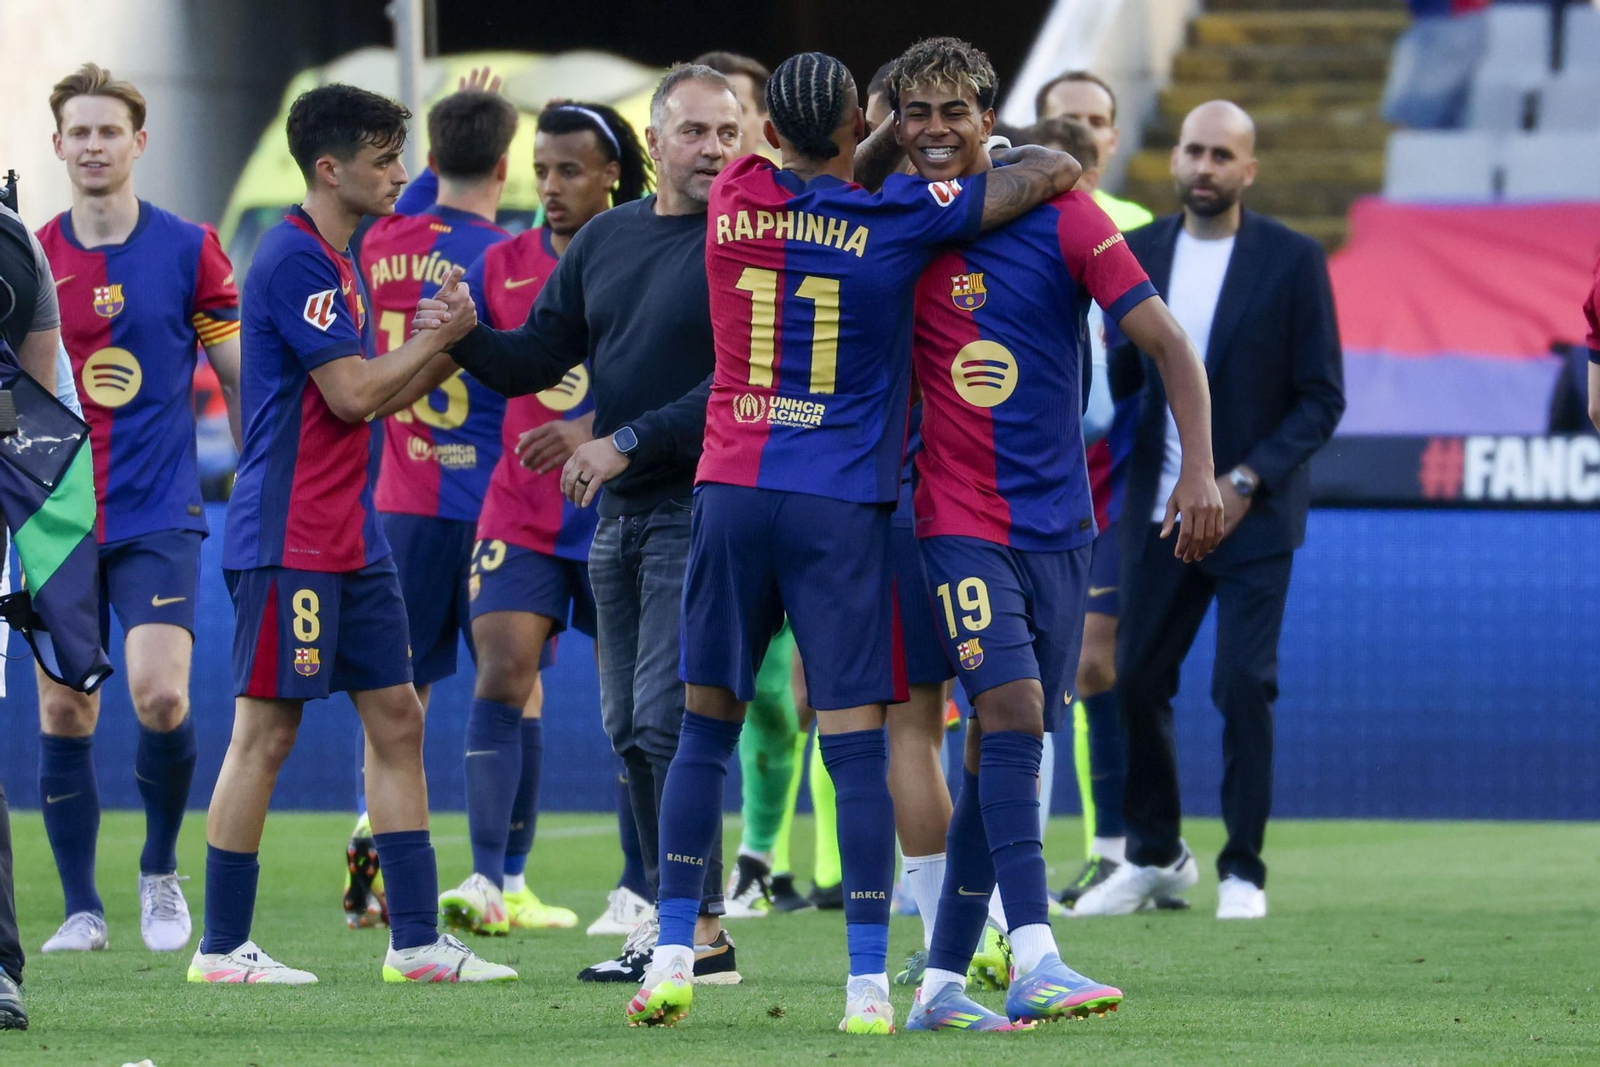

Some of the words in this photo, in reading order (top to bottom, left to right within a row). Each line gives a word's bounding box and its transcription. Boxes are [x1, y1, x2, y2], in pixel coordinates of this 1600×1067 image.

[716, 210, 869, 258] RAPHINHA
[370, 254, 408, 290] PAU
[411, 251, 466, 285] VÍC
[735, 267, 840, 395] 11
[767, 408, 822, 426] ACNUR
[769, 395, 826, 415] UNHCR
[292, 588, 321, 643] 8
[937, 576, 992, 639] 19
[667, 852, 704, 866] BARÇA
[850, 891, 886, 900] BARÇA
